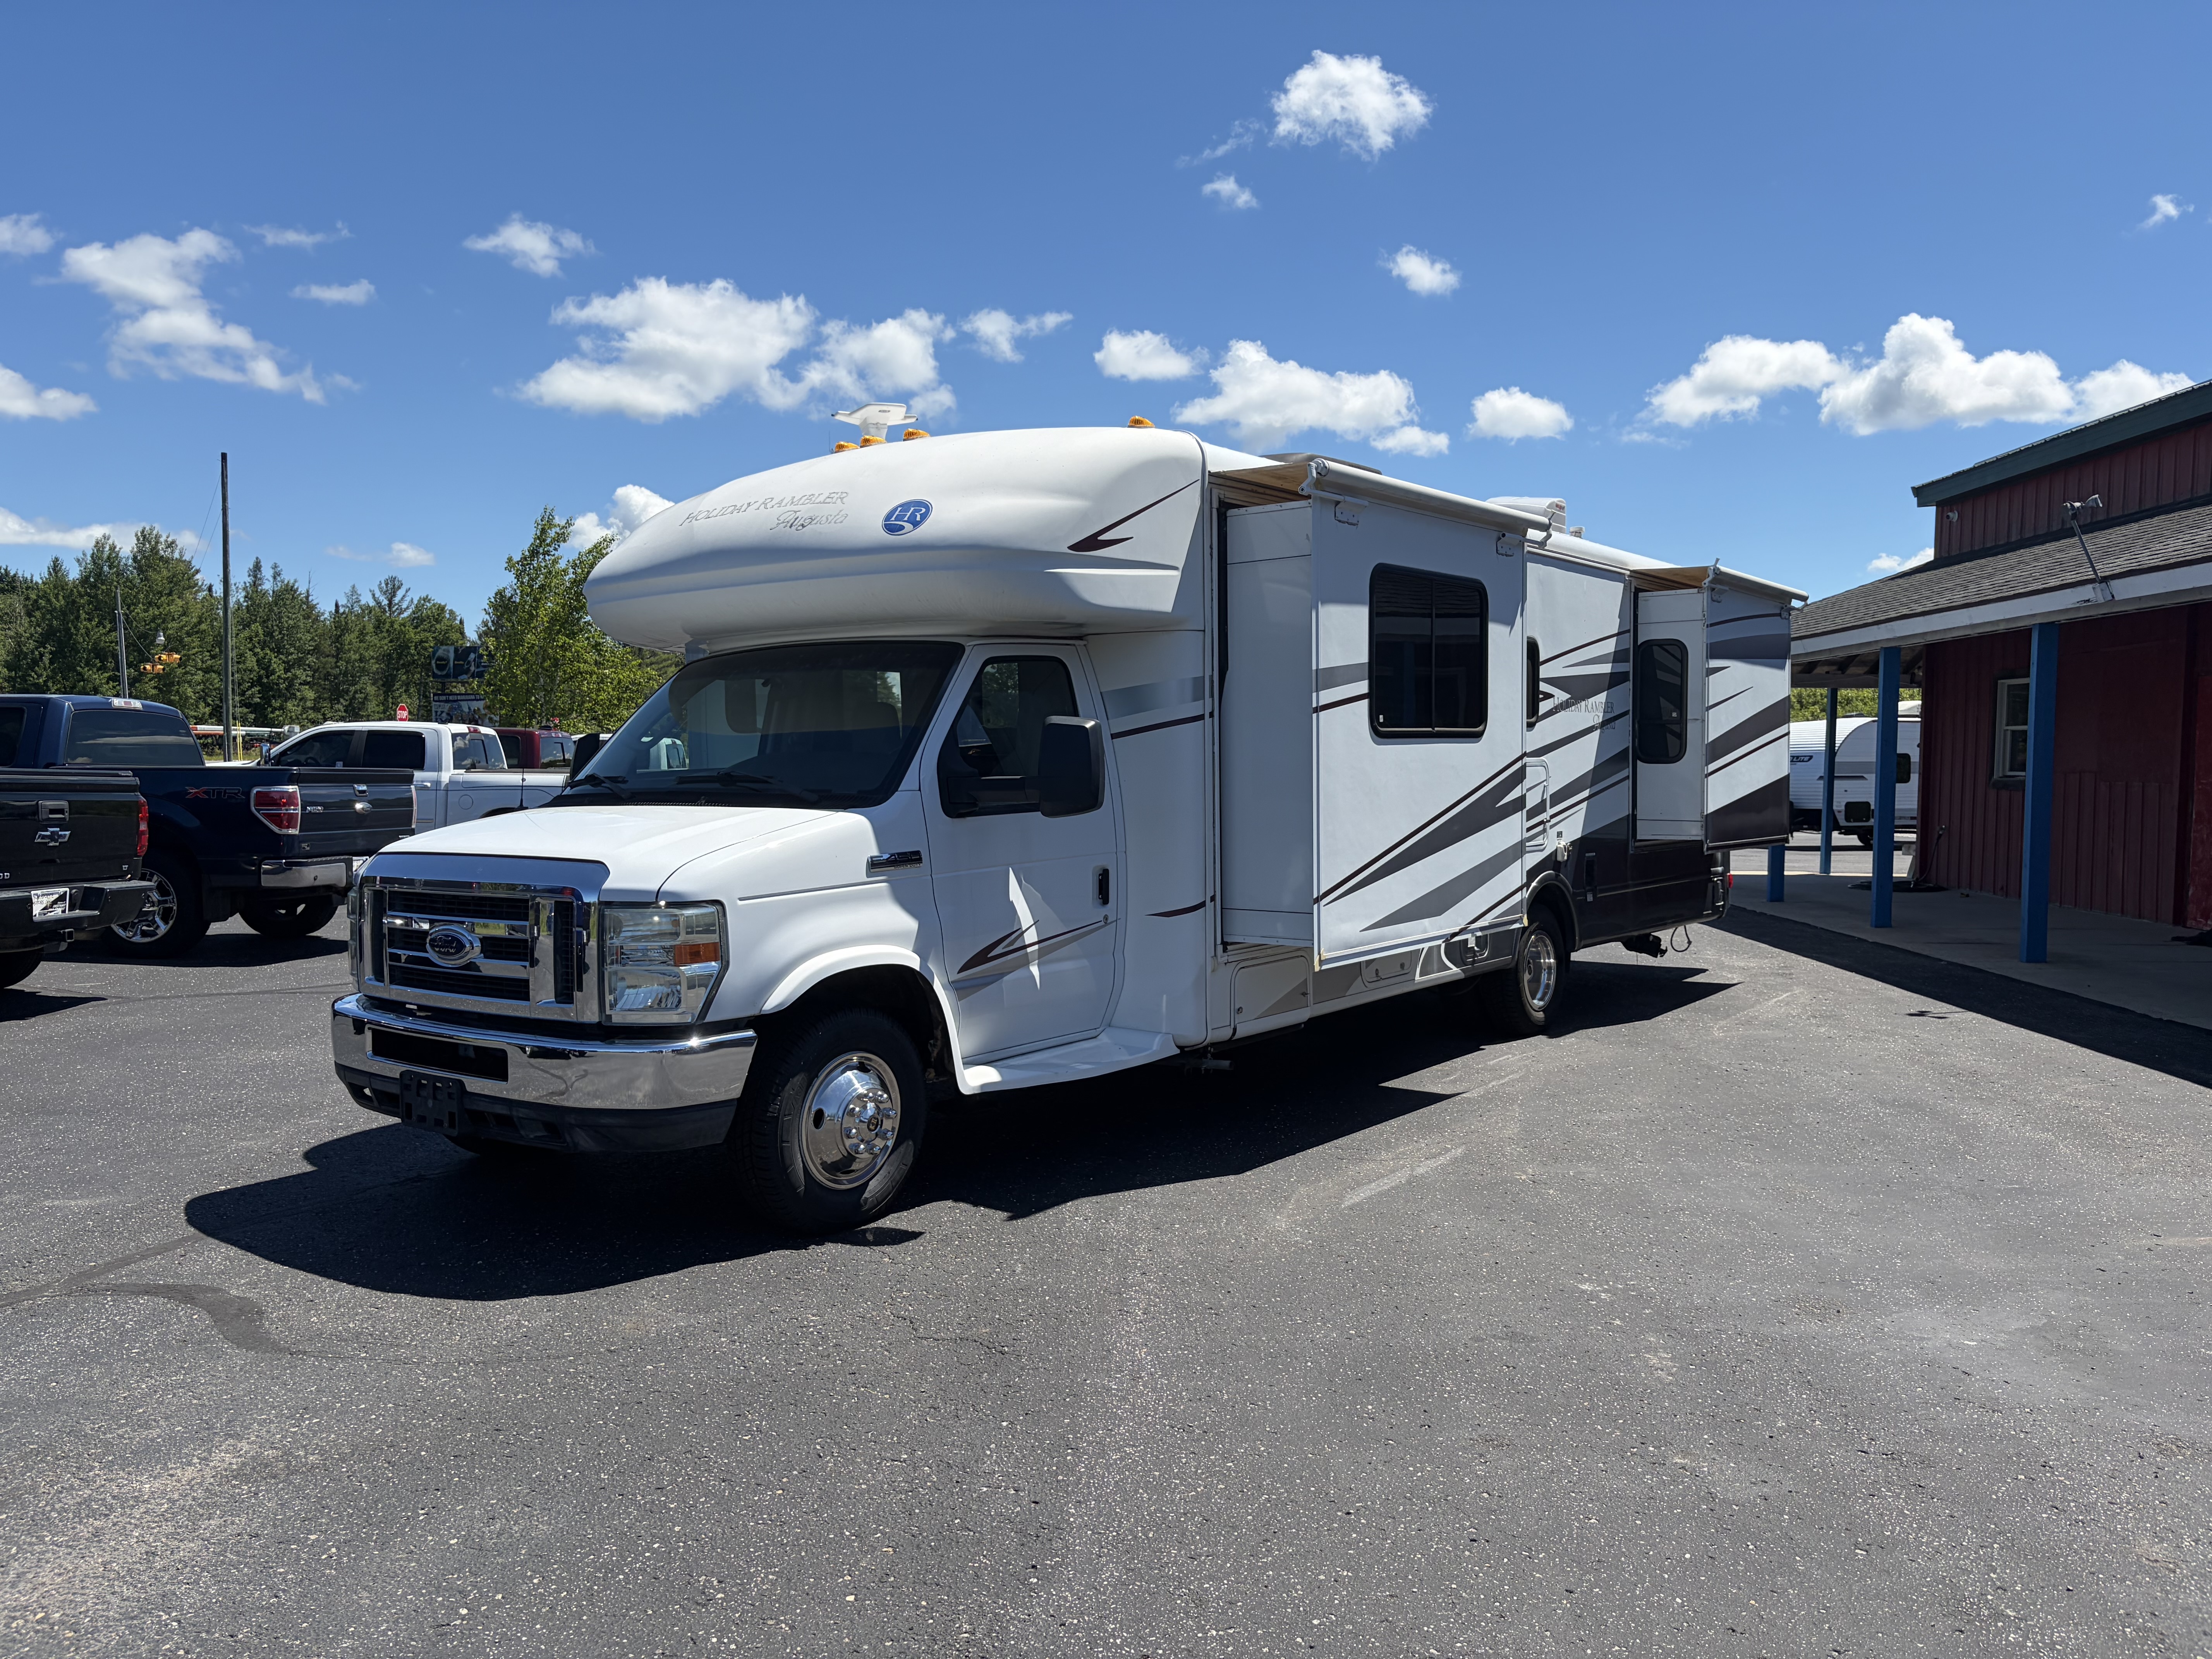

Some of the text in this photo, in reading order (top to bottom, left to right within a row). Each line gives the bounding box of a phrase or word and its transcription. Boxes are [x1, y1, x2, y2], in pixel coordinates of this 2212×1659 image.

[679, 491, 849, 526] HOLIDAY RAMBLER
[890, 507, 926, 521] HR
[770, 508, 848, 531] Augusta
[1553, 697, 1615, 713] HOLIDAY RAMBLER
[398, 710, 407, 719] STOP
[185, 787, 246, 799] XTR
